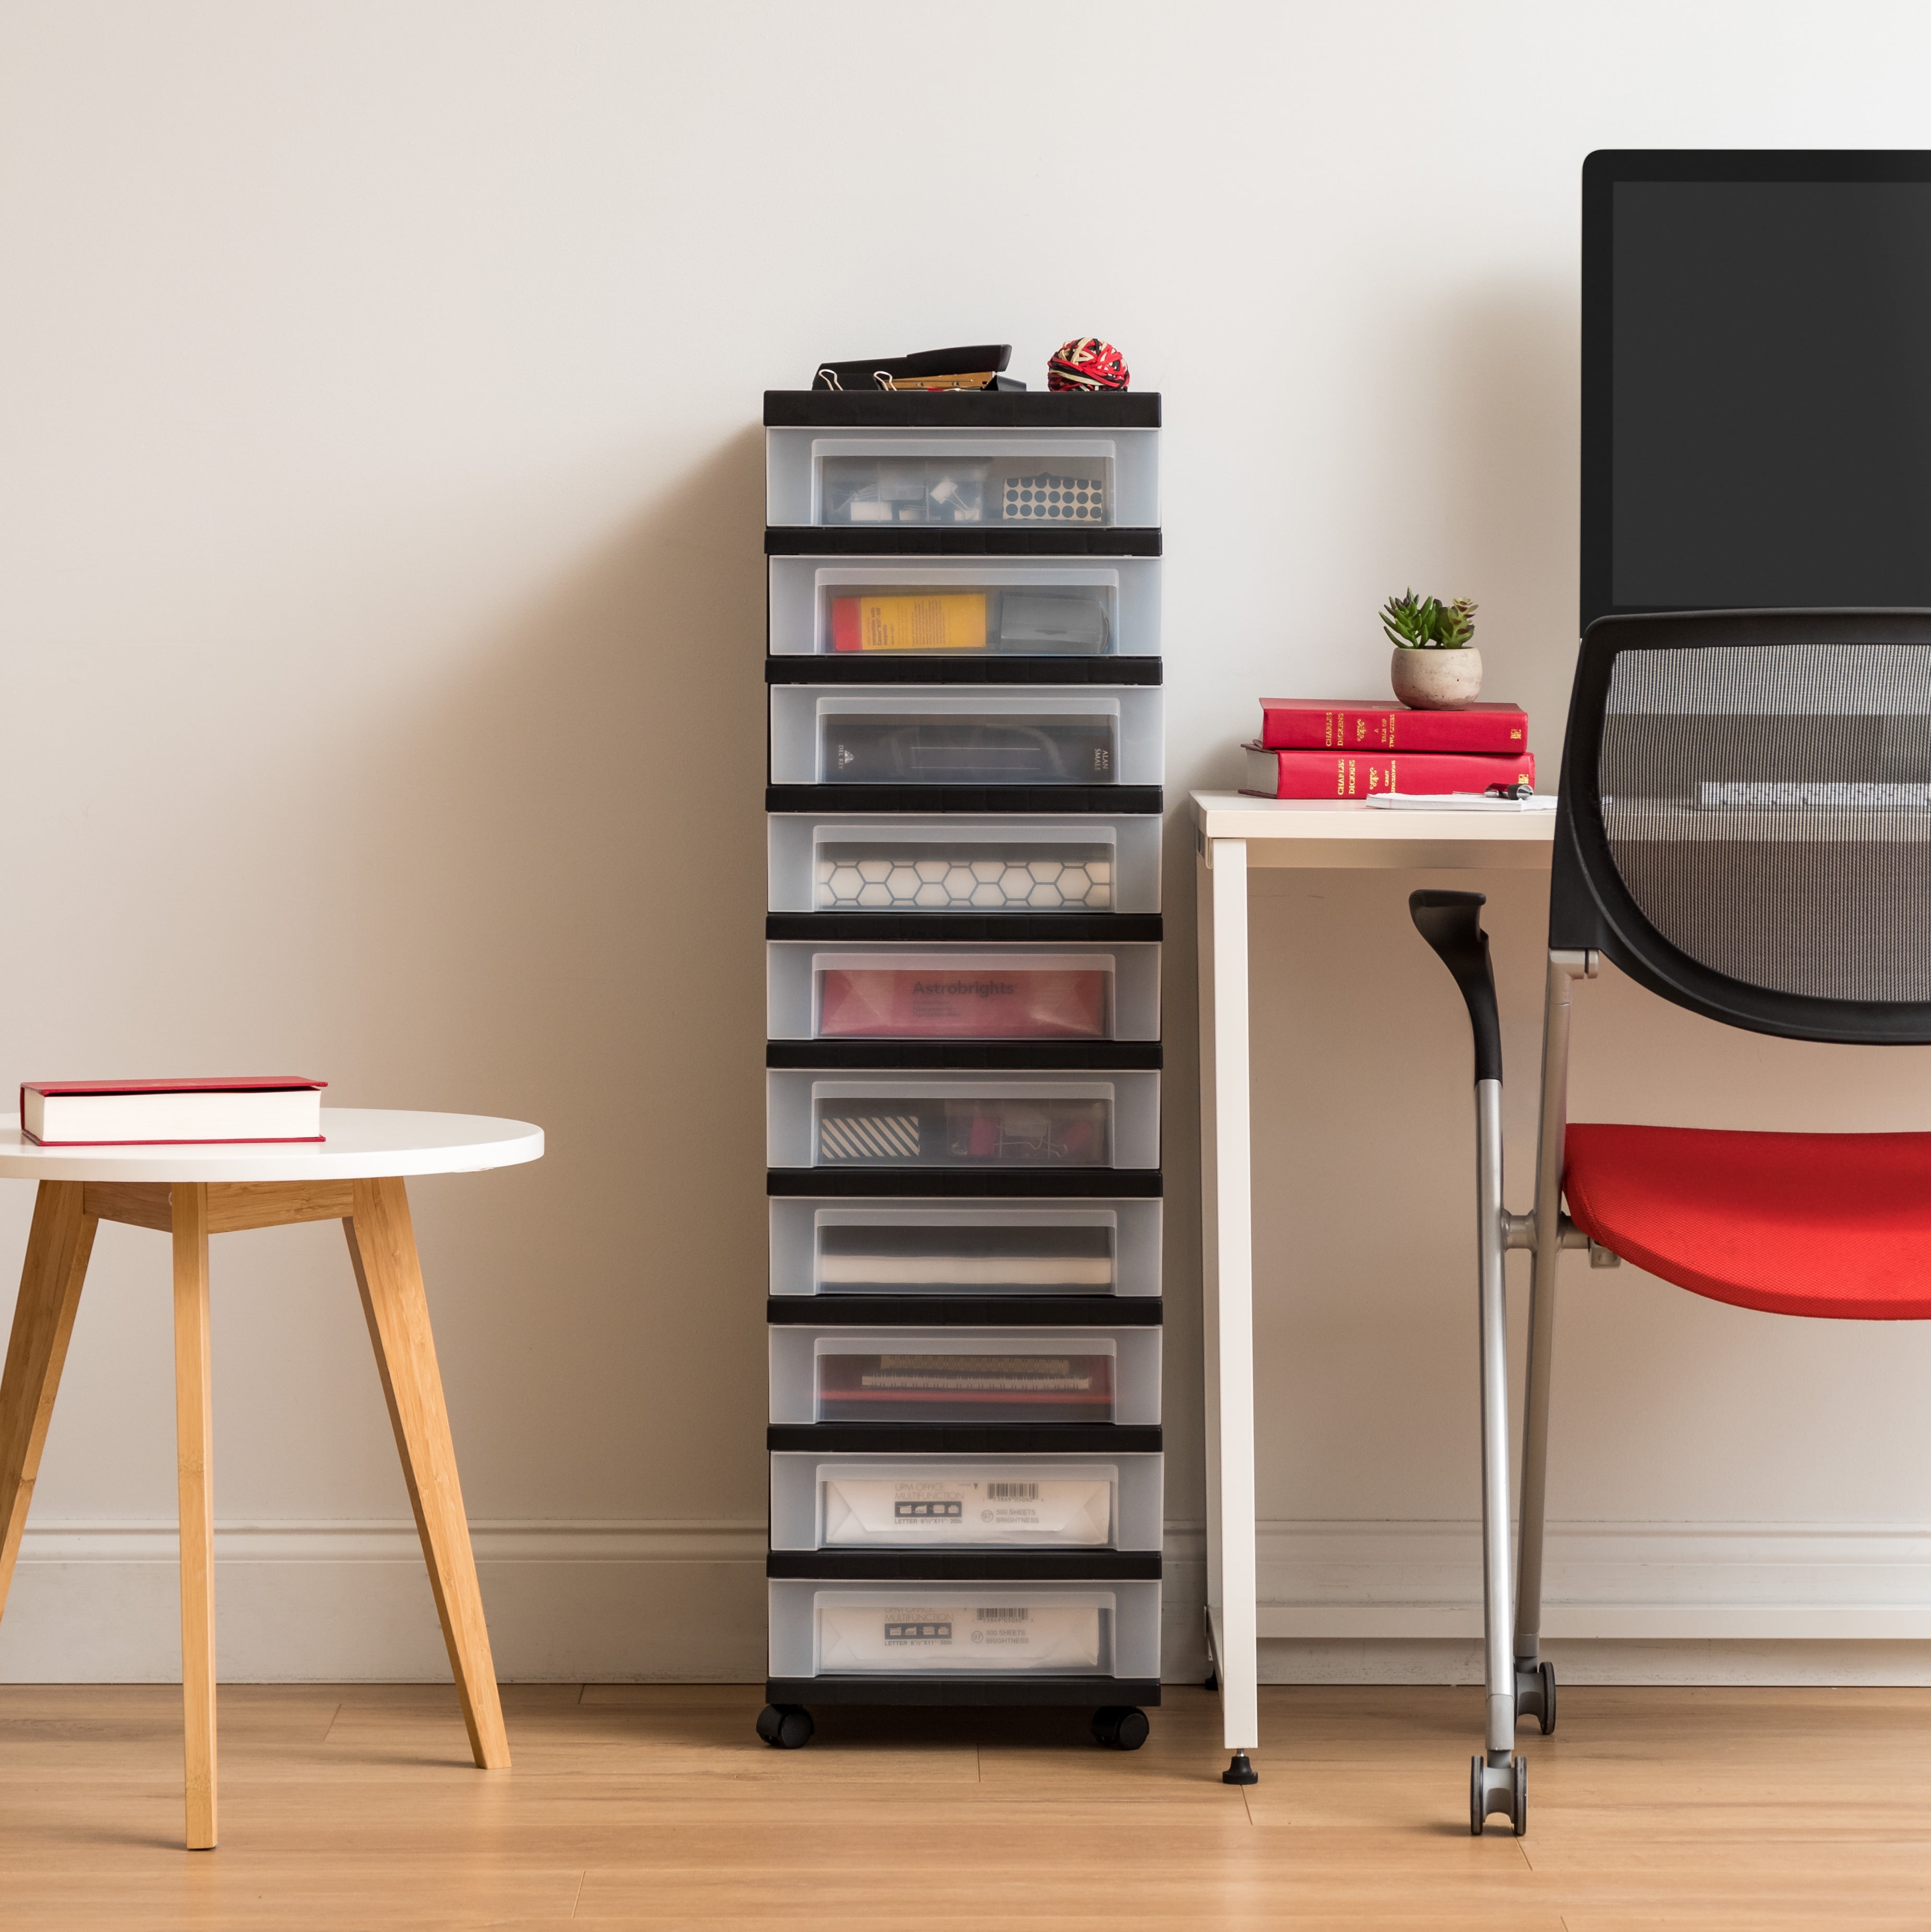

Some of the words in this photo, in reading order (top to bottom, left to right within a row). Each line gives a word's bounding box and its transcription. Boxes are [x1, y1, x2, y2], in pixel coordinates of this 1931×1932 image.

[1381, 718, 1387, 727] OF
[913, 980, 1014, 998] Astrobrights
[895, 1483, 913, 1491] UPM
[916, 1483, 944, 1491] OFFICE
[895, 1492, 964, 1500] MULTIFUNCTION
[884, 1613, 954, 1621] MULTIFUNCTION
